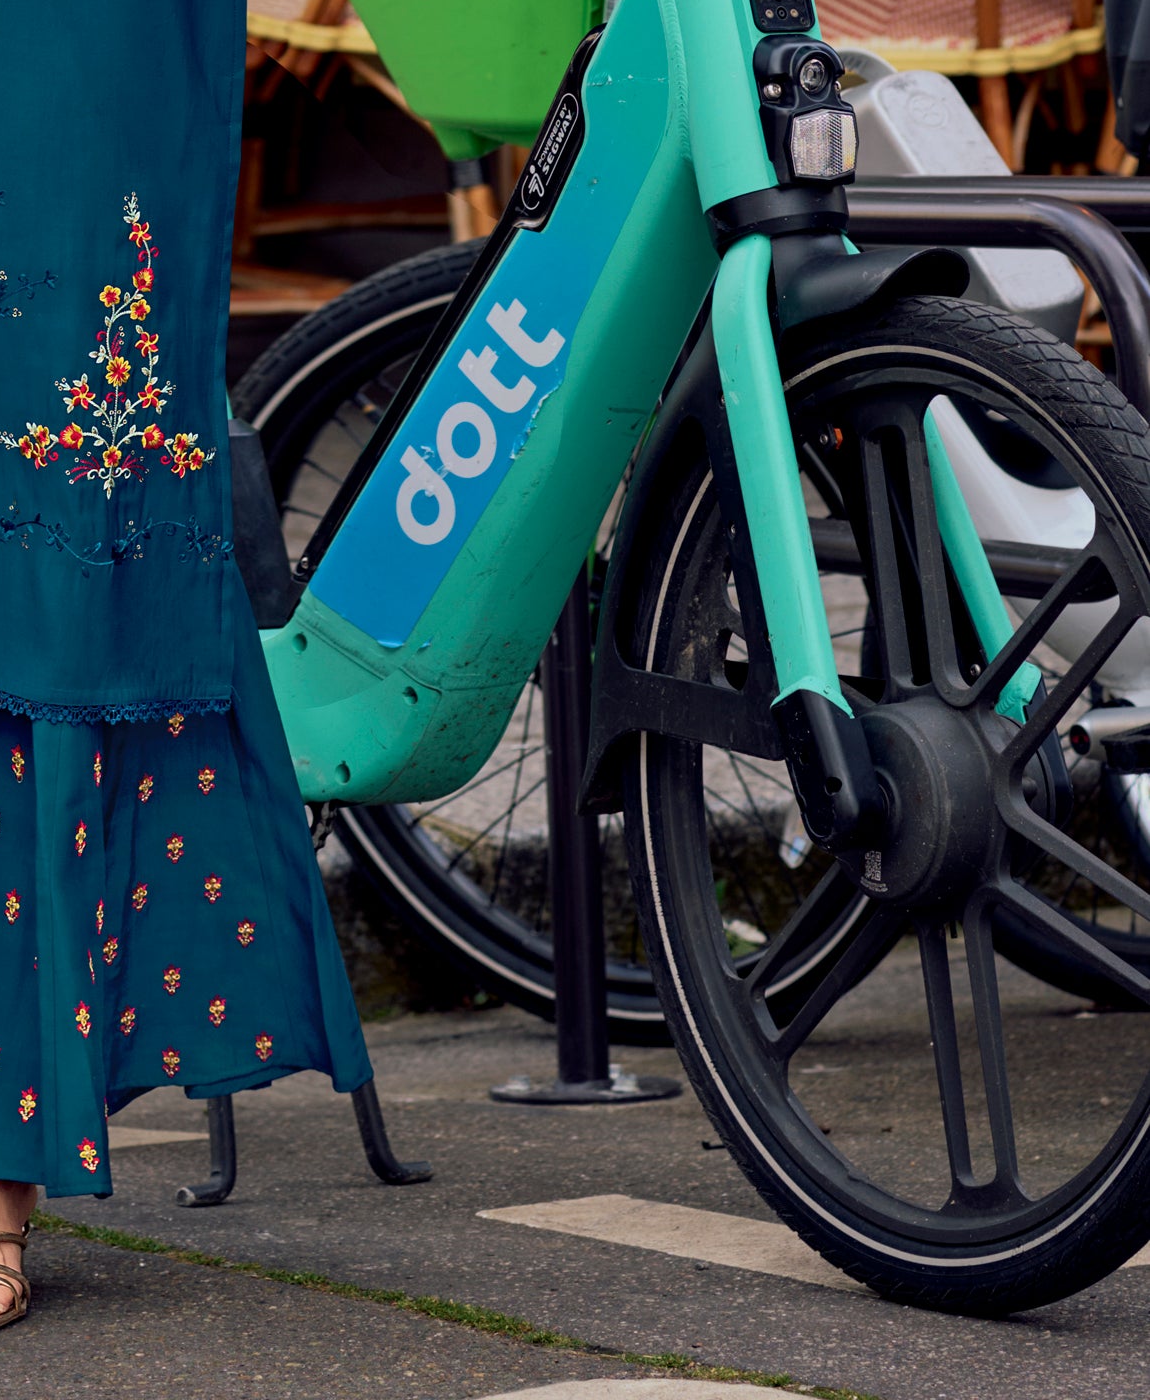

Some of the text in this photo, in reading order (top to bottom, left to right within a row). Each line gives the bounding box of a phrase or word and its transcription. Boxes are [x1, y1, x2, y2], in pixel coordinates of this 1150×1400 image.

[537, 103, 568, 167] POWERED BY
[541, 109, 573, 175] SEGWAY
[396, 298, 566, 546] dott
